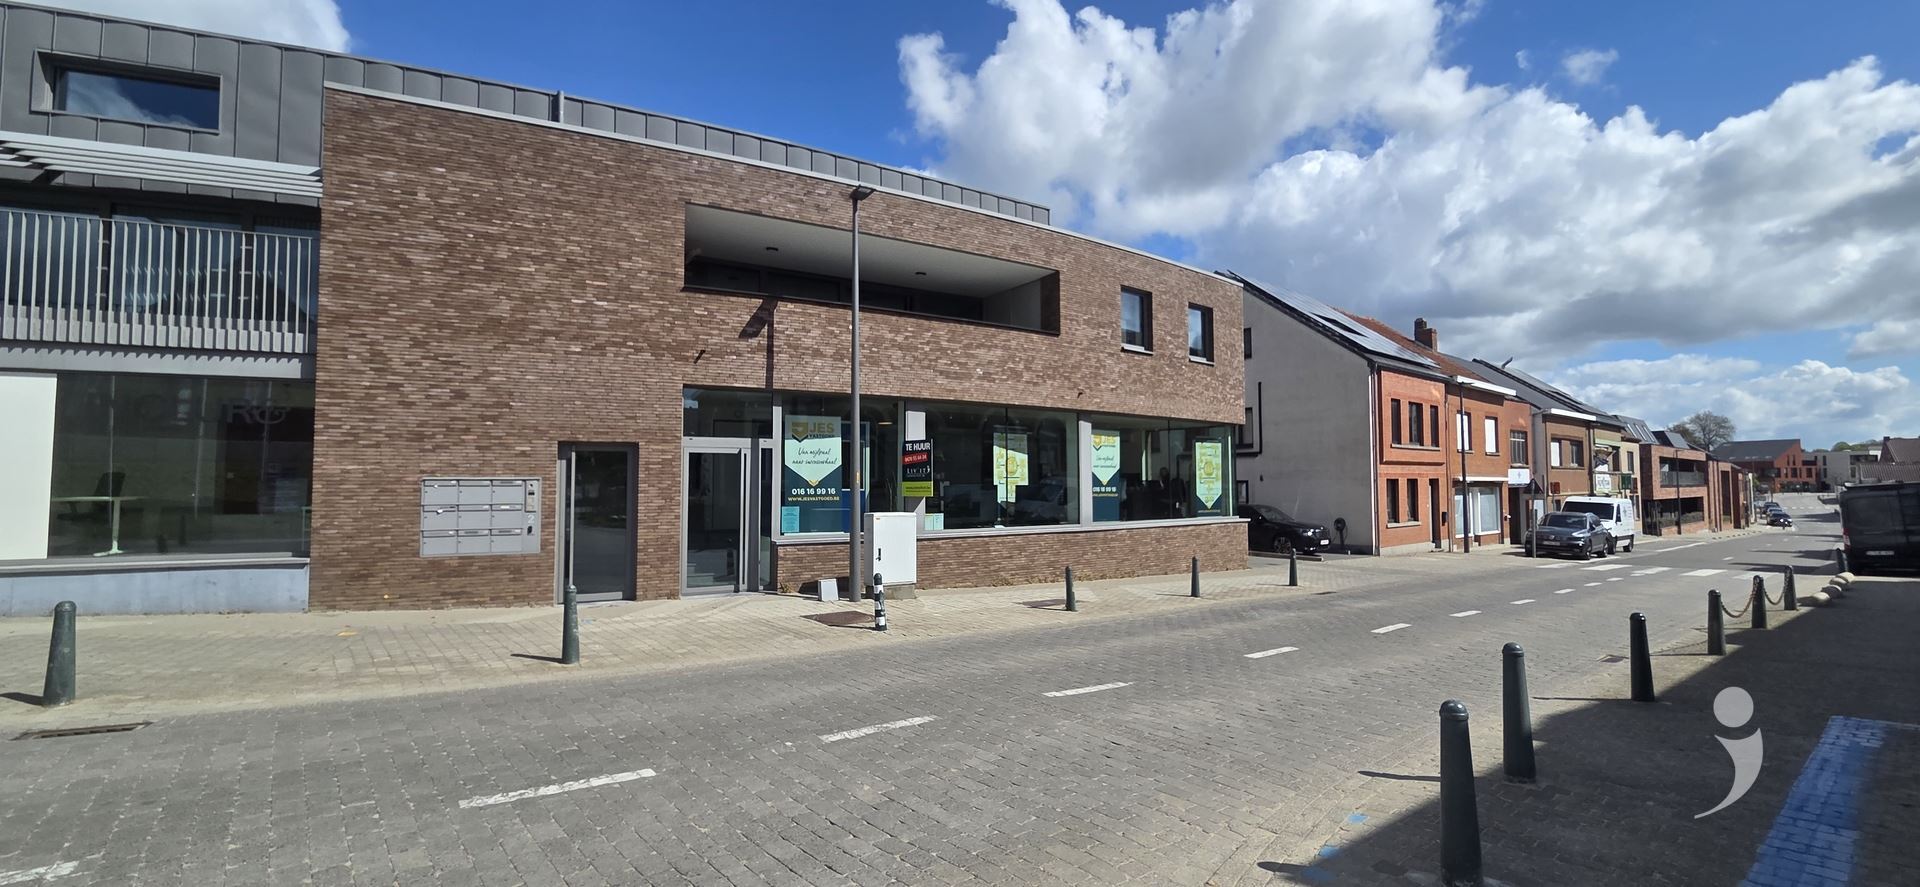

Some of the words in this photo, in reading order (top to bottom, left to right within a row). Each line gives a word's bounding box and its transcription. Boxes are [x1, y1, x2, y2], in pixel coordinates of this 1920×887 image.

[810, 422, 834, 433] JES
[914, 442, 930, 450] HUUR
[528, 515, 534, 523] 2
